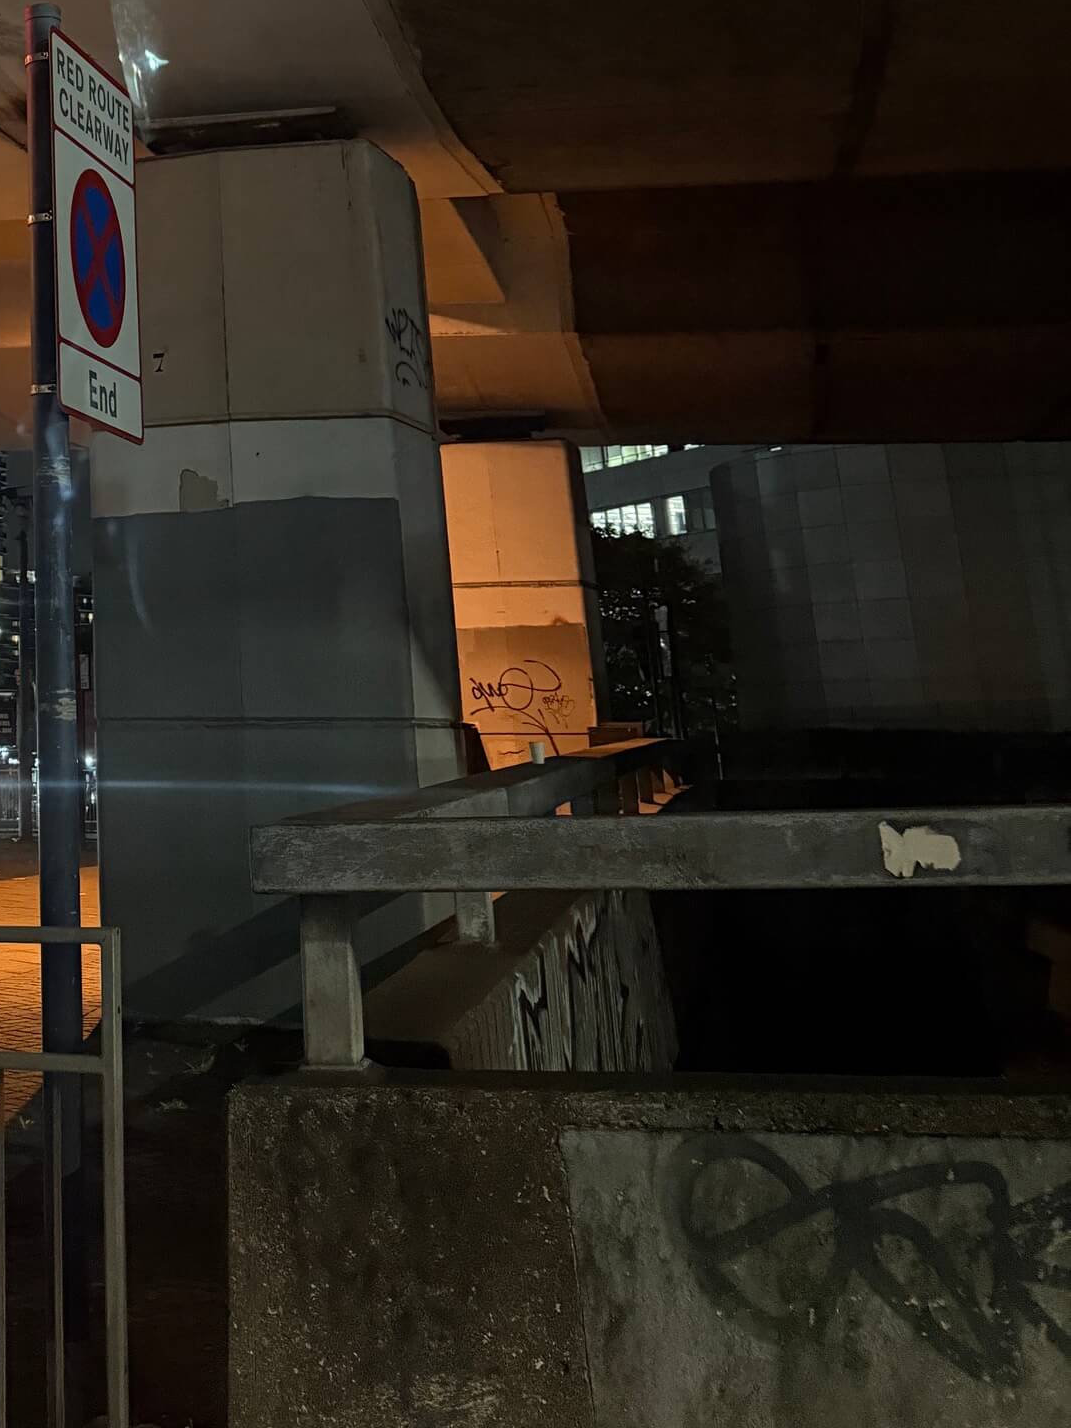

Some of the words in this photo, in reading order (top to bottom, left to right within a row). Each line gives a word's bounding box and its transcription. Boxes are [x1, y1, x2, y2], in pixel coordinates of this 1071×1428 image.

[56, 47, 84, 93] RED
[89, 74, 129, 133] ROUTE
[59, 88, 129, 165] CLEARWAY
[89, 369, 117, 419] End
